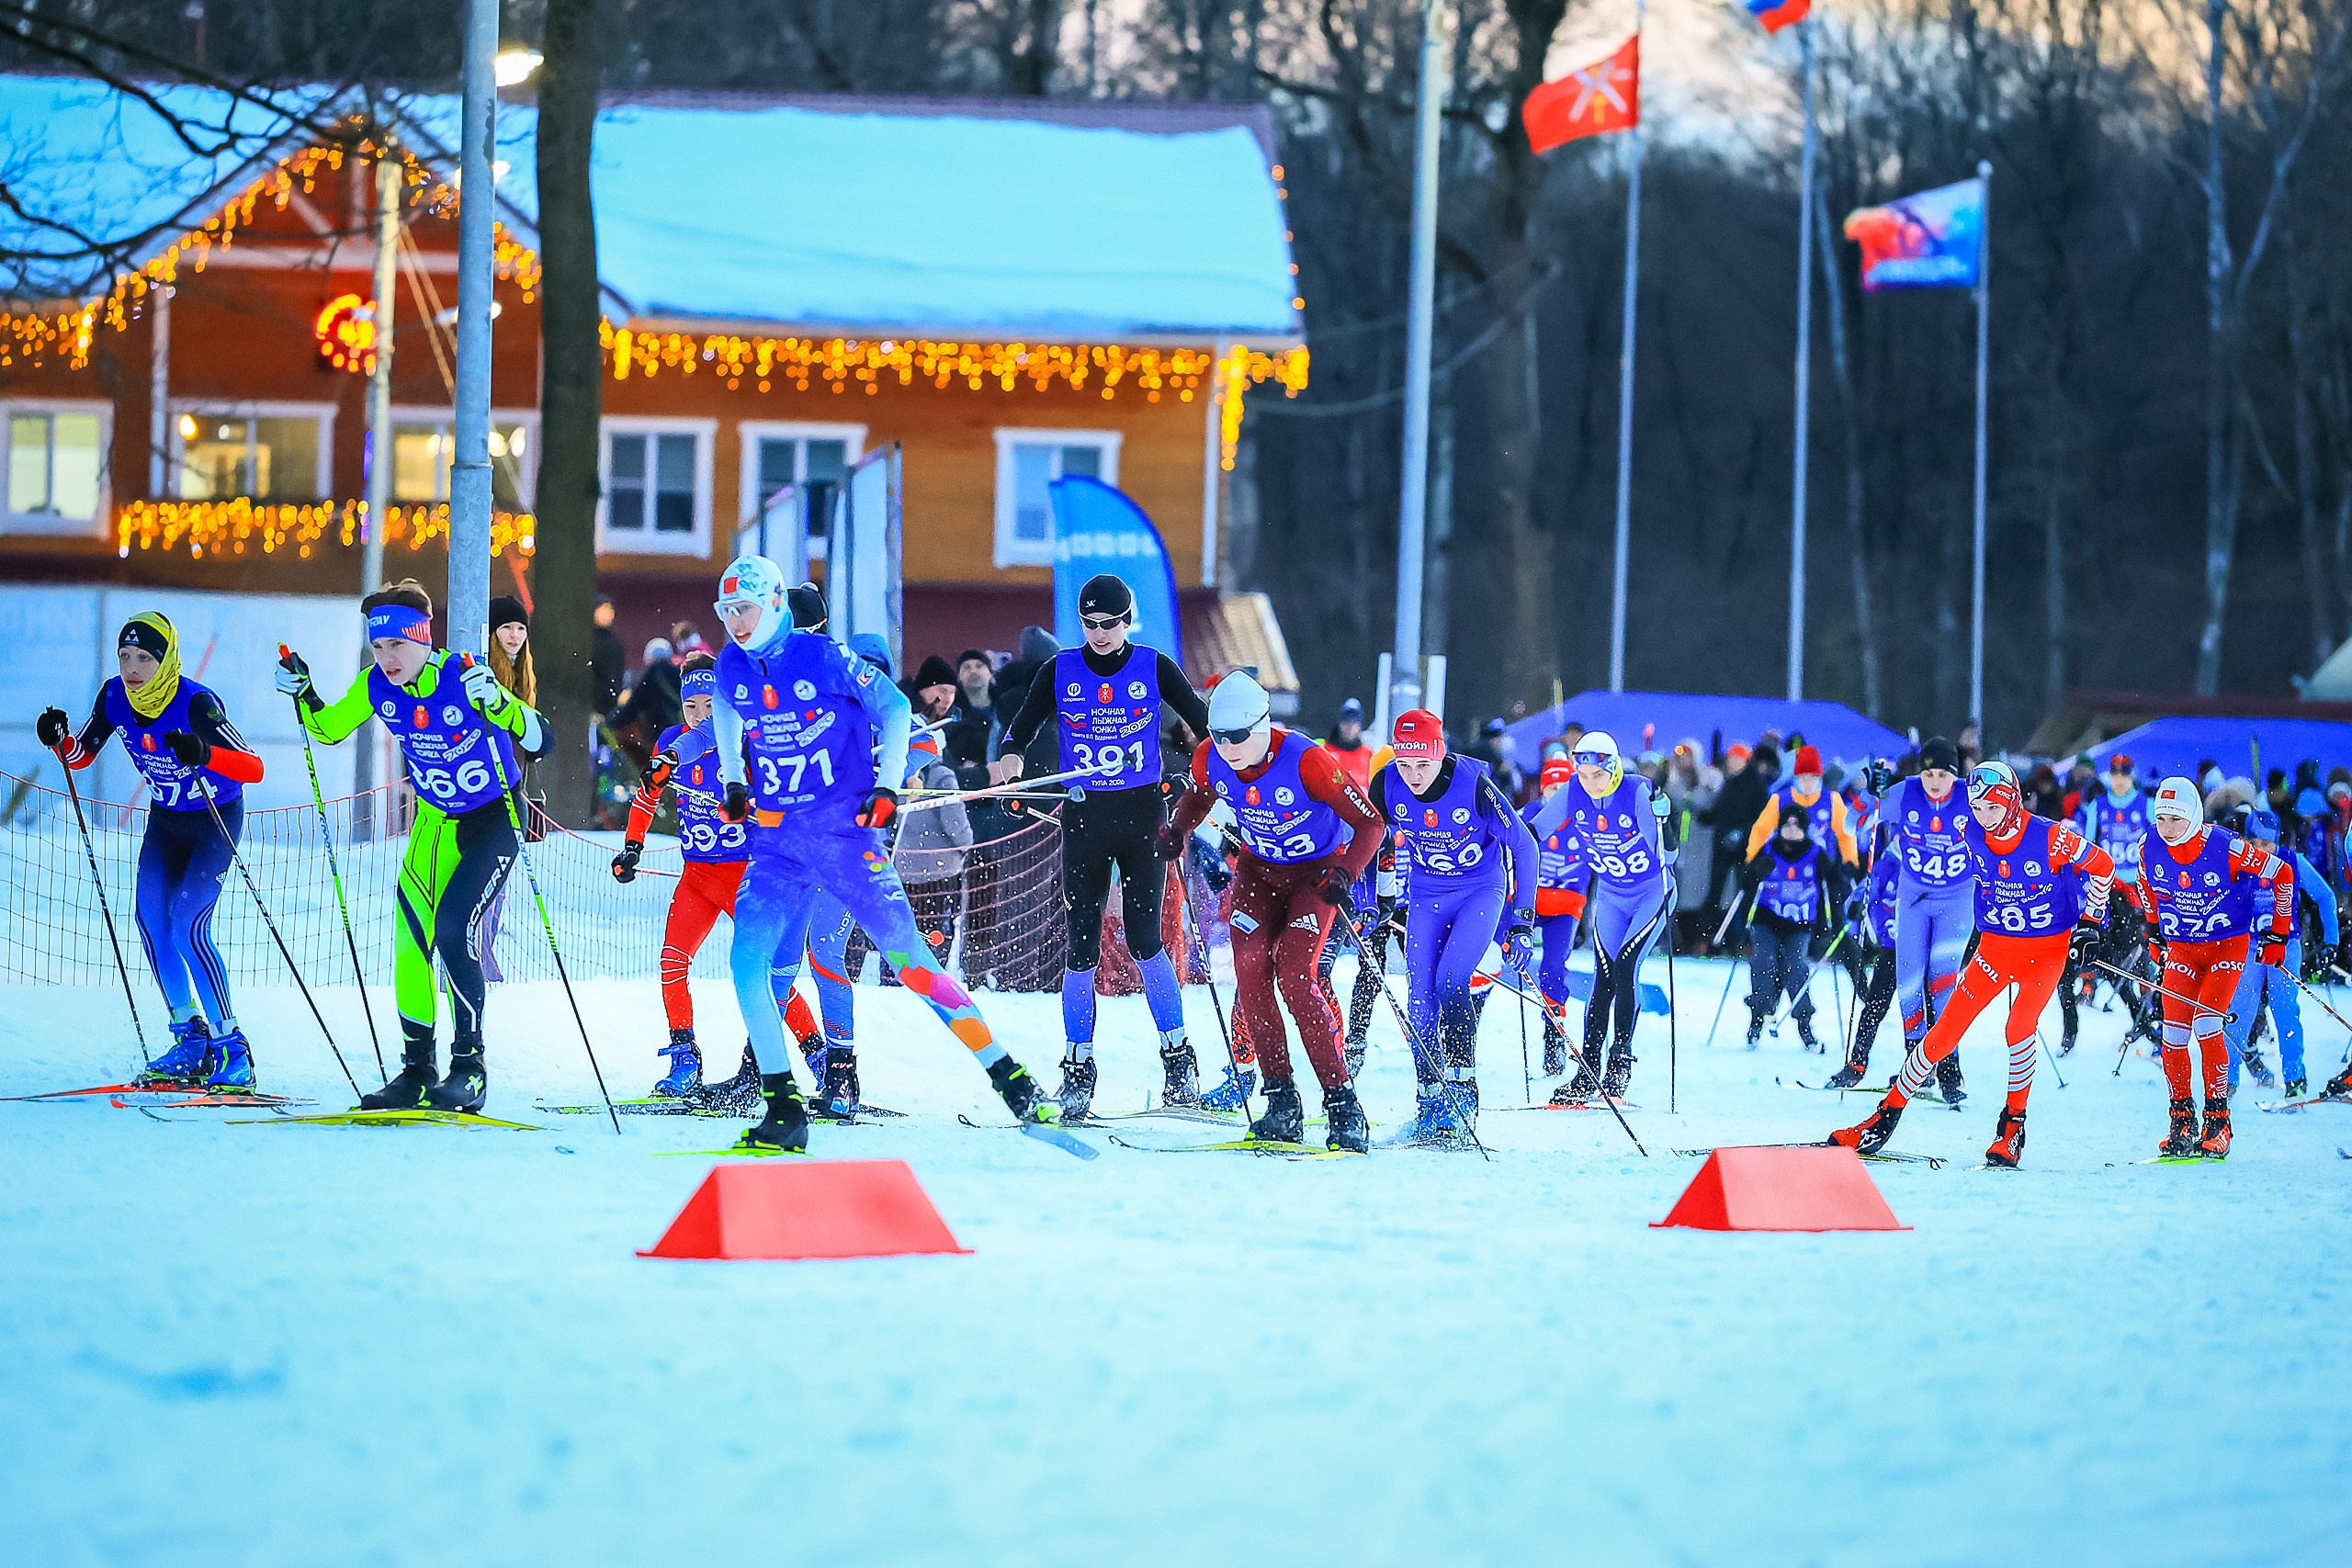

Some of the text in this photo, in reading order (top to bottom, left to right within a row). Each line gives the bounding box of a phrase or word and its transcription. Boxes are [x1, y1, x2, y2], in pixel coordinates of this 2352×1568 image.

[682, 672, 717, 689] UKOI
[1091, 708, 1125, 716] НОЧНАЯ
[1091, 716, 1127, 725] ЛЫЖНАЯ
[757, 748, 835, 795] 371
[1073, 741, 1144, 777] 391
[1419, 829, 1452, 840] НОЧНАЯ
[1587, 847, 1650, 878] 398
[1906, 847, 1967, 879] 248
[467, 867, 503, 962] FISCHER
